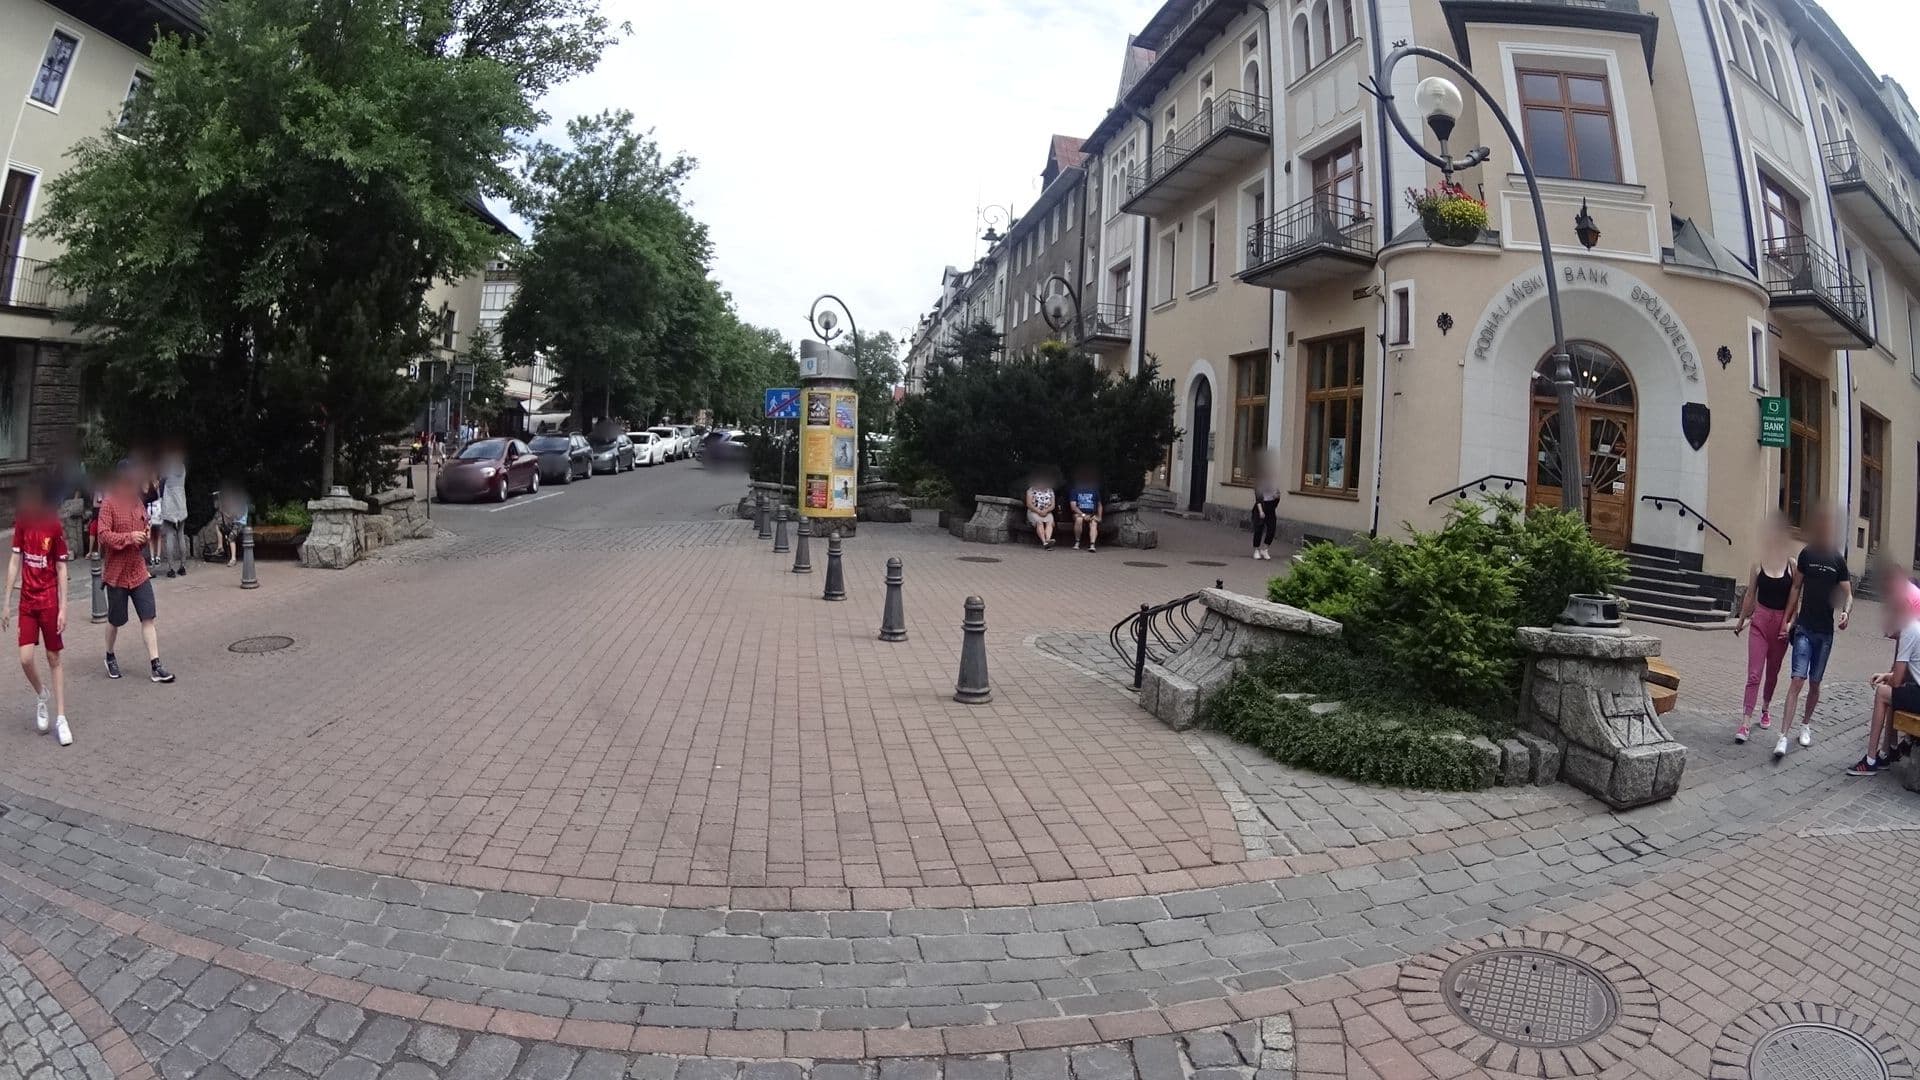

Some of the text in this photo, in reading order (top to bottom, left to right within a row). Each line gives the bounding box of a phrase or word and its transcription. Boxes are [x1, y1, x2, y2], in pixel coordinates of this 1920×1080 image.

[1474, 266, 1699, 383] PODHALAŃSKI BANK SPÓŁDZIELCZY
[1763, 422, 1784, 432] BANK
